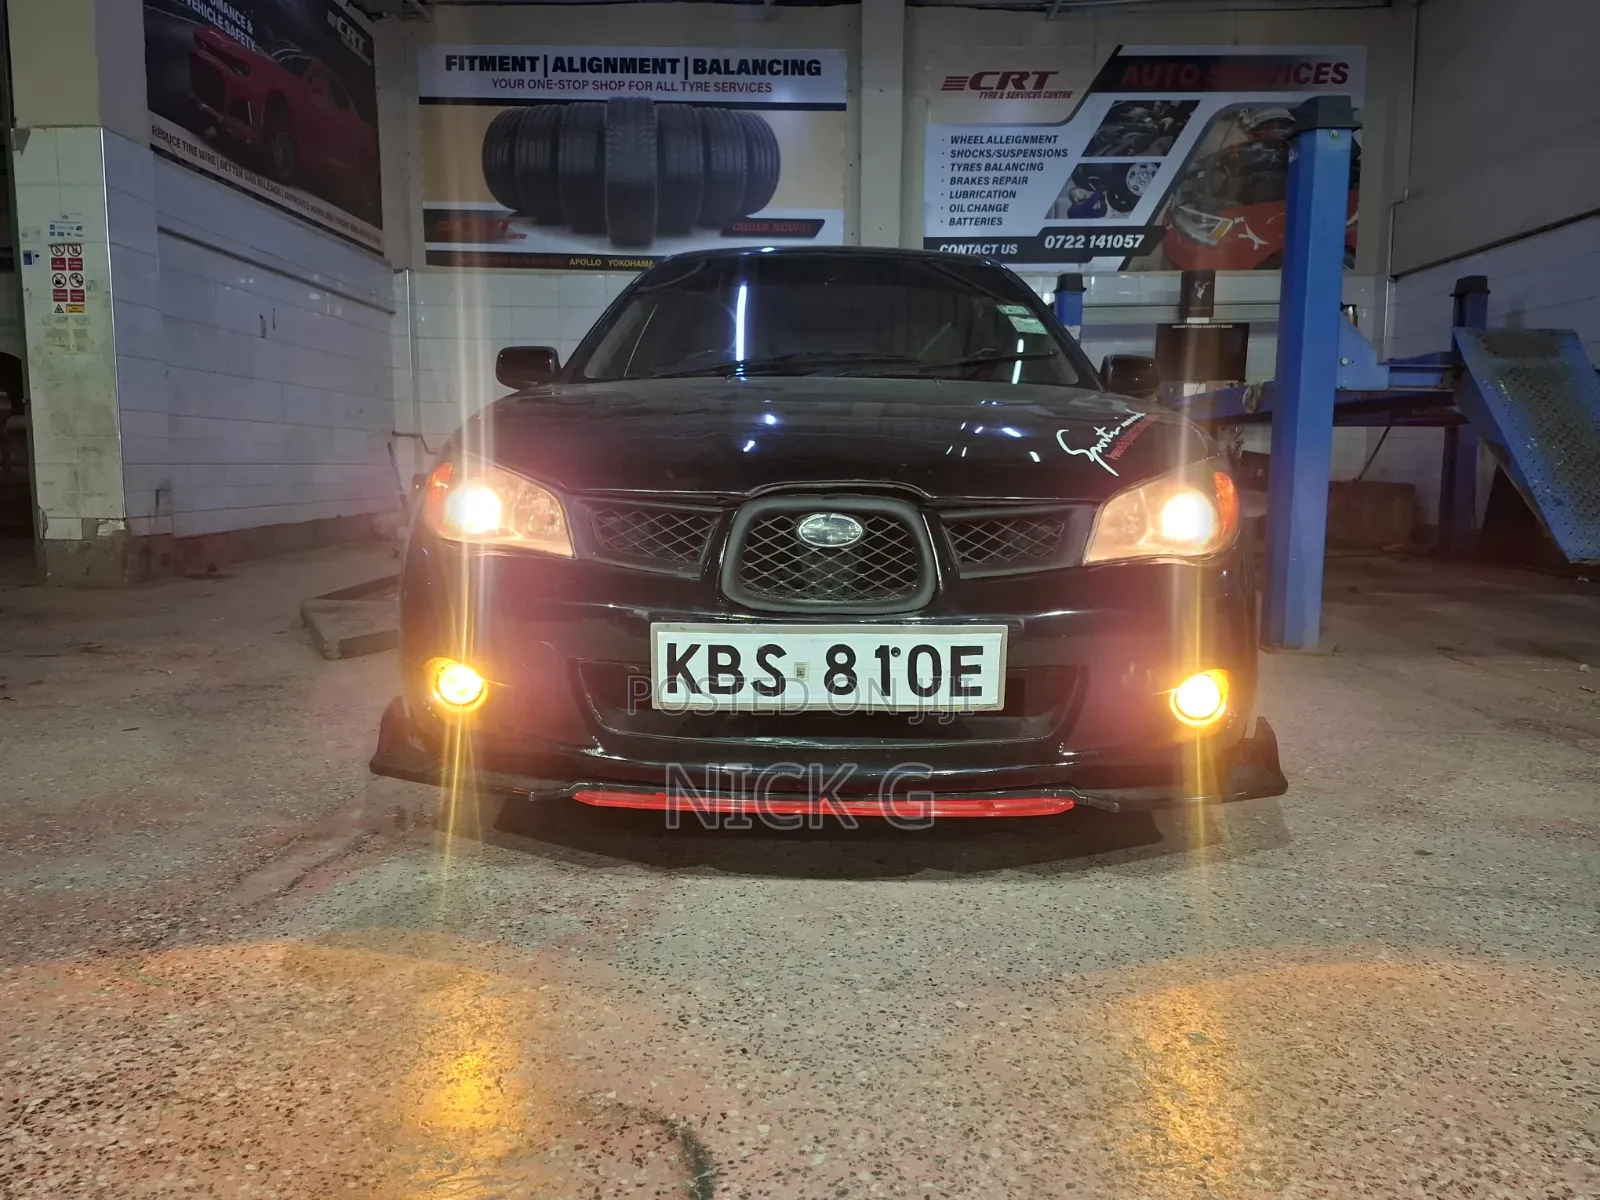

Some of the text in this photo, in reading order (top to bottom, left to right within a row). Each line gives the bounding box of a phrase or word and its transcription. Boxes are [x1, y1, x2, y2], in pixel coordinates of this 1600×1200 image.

[246, 20, 254, 35] &
[336, 16, 368, 52] CRT
[224, 20, 256, 52] SAFETY
[445, 55, 822, 76] FITMENT ALIGNMENT BALANCING
[969, 71, 1059, 90] CRT
[1121, 62, 1200, 87] AUTO
[491, 78, 773, 93] YOUR ONE-STOP SHOP FOR ALL TYRE SERVICES
[979, 91, 998, 99] TYRE
[1006, 91, 1042, 99] SERVICES
[1042, 91, 1073, 99] CENTRE
[950, 135, 1059, 144] WHEEL ALLEIGNMENT
[151, 125, 182, 149] REDUCE
[182, 140, 198, 157] TIRE
[219, 160, 244, 179] BETTER
[950, 149, 1068, 158] SHOCKS/SUSPENSIONS
[950, 162, 1044, 172] TYRES BALANCING
[949, 176, 1029, 186] BRAKES REPAIR
[949, 190, 1017, 199] LUBRICATION
[949, 203, 1009, 213] OIL CHANGE
[948, 217, 1003, 226] BATTERIES
[1044, 234, 1145, 249] 0722 141057
[939, 244, 1019, 255] CONTACT US
[569, 258, 602, 267] APOLLO
[607, 259, 654, 268] YOKOHAMA
[666, 643, 984, 697] KBS 810E
